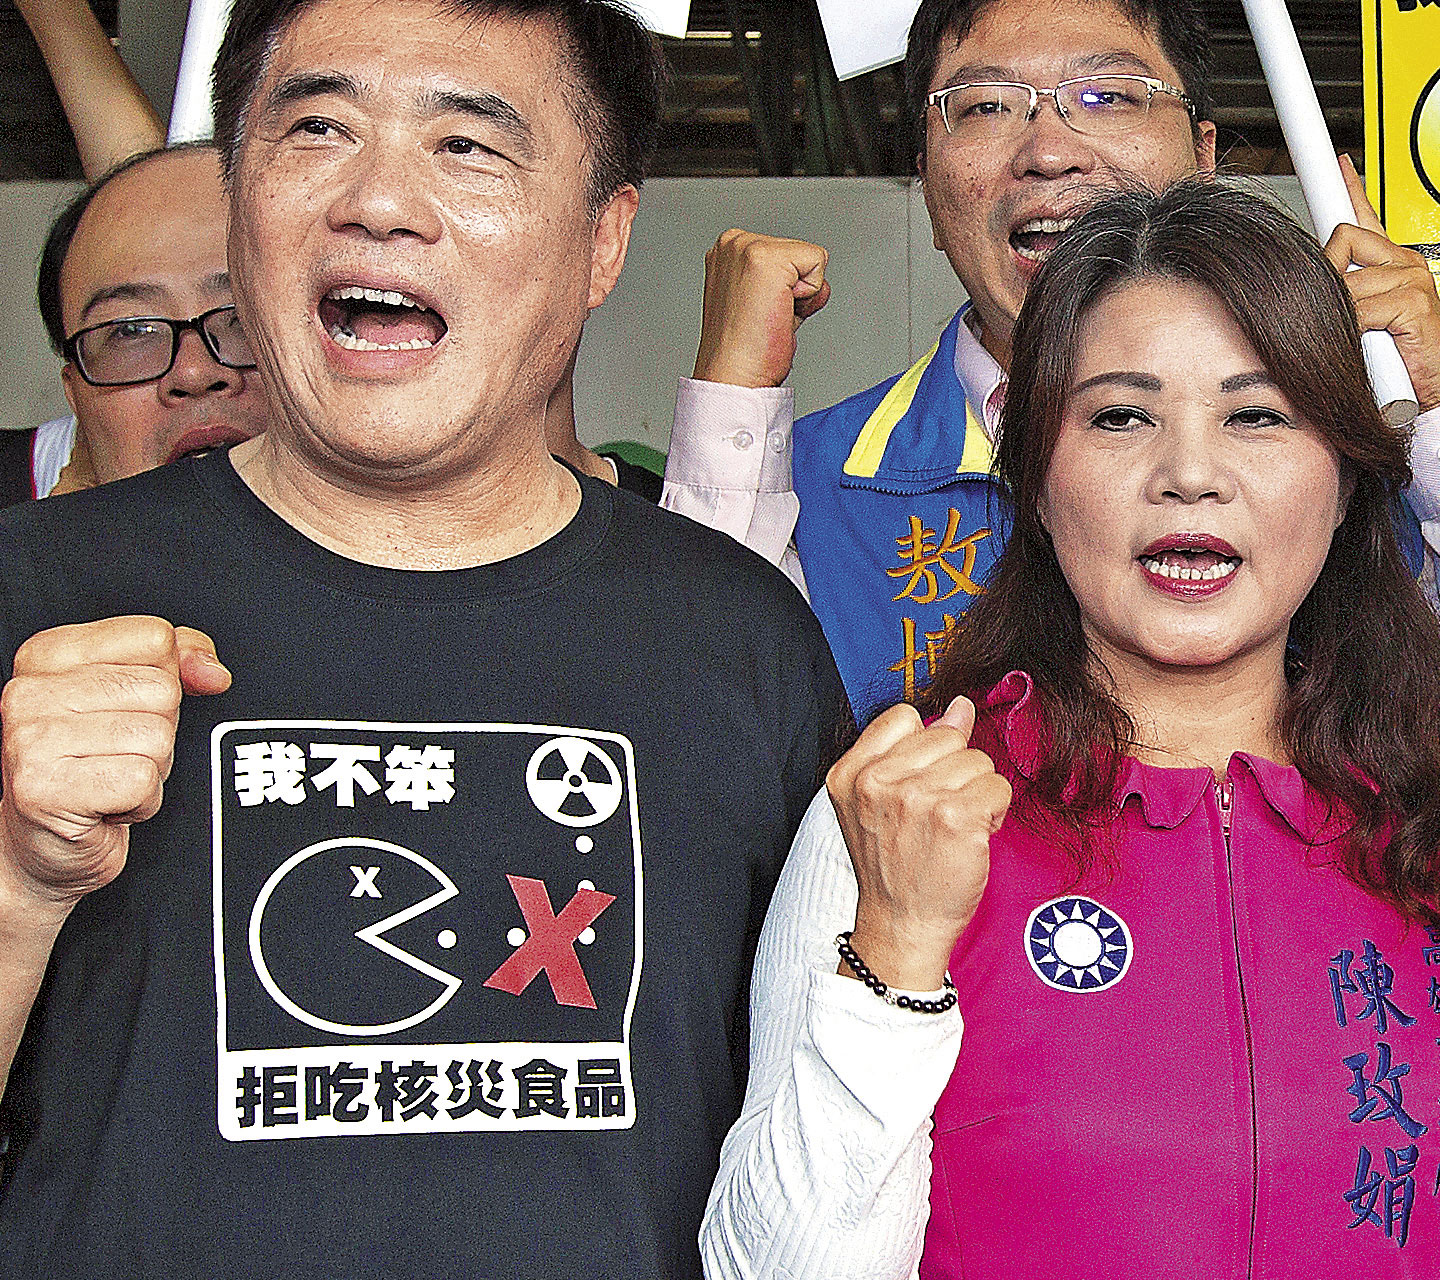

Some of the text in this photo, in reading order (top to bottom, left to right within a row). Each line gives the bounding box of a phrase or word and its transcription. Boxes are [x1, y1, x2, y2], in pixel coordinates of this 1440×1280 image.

[234, 742, 456, 811] 我不笨
[236, 1059, 626, 1128] 拒吃核災食品
[1328, 940, 1428, 1248] 陳玫娟
